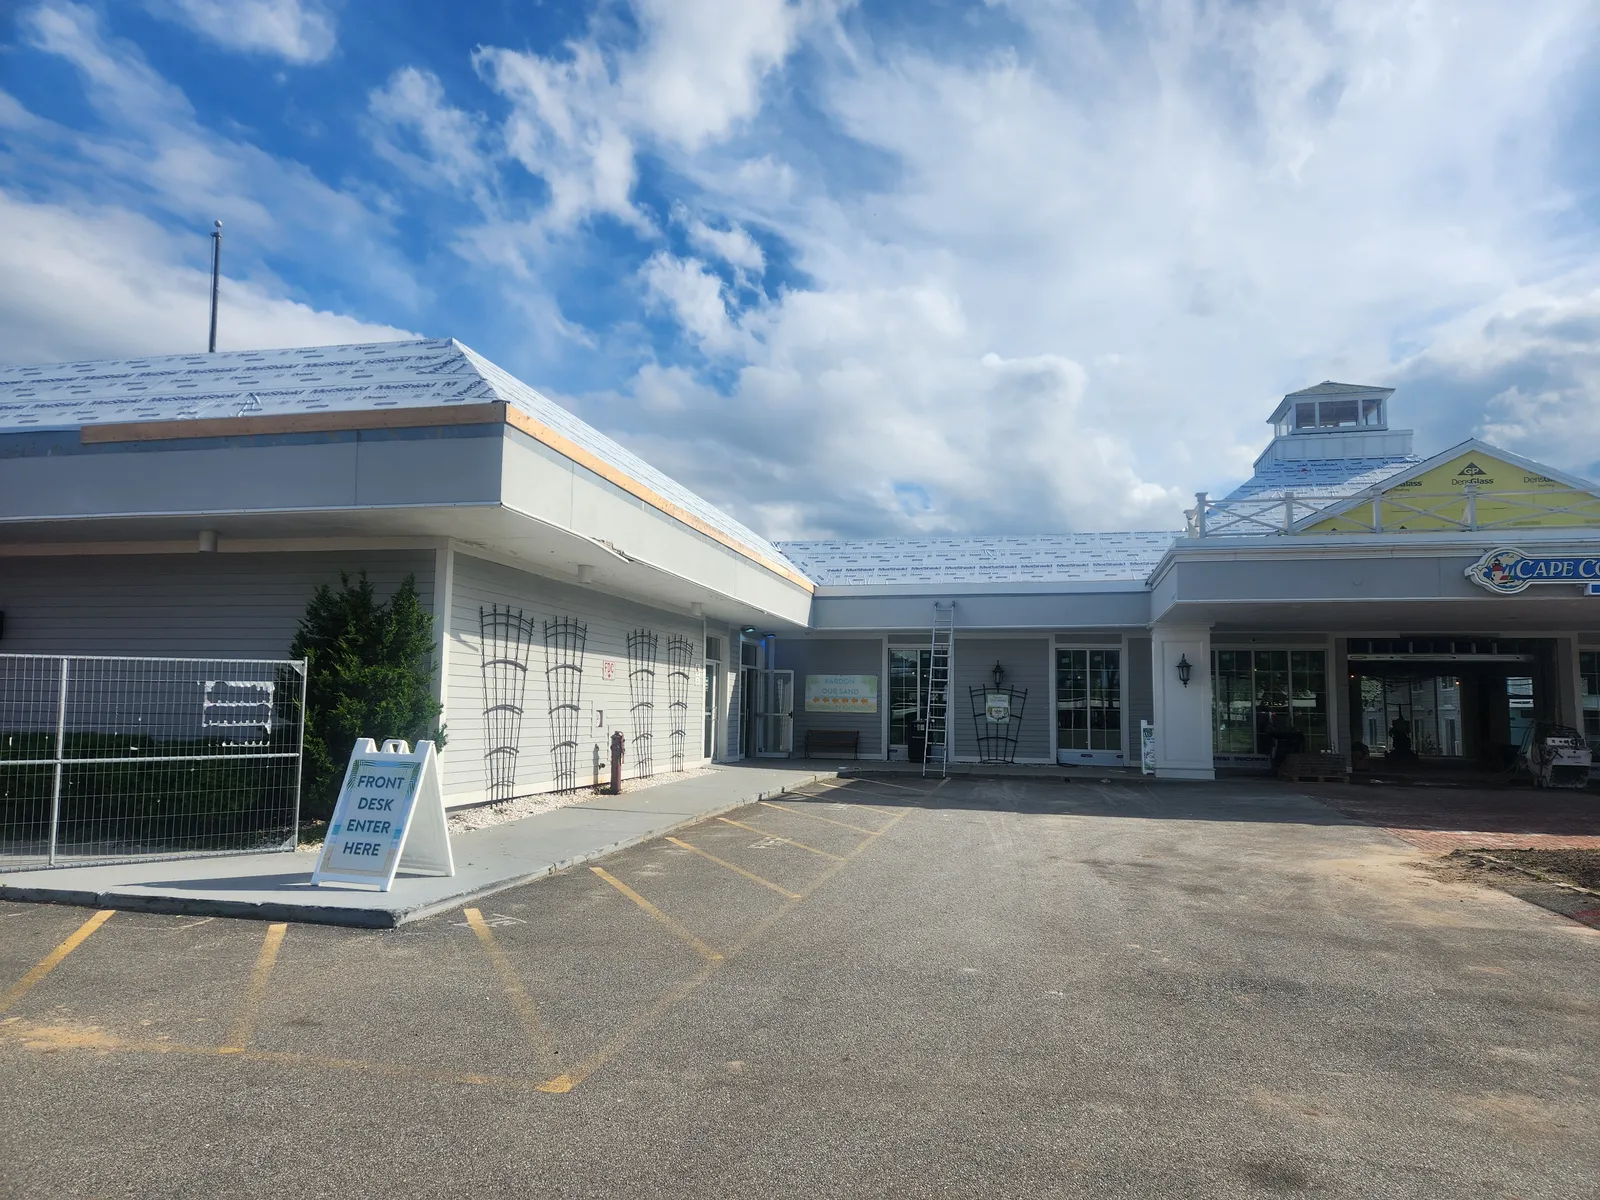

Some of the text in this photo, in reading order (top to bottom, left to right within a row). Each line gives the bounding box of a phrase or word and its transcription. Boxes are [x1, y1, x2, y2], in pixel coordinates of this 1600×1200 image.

[376, 382, 437, 391] MetShield
[1464, 467, 1479, 475] GP
[1516, 559, 1575, 579] CAPE
[604, 662, 614, 673] FDC
[821, 687, 838, 695] OUR
[357, 775, 405, 790] FRONT
[357, 797, 395, 812] DESK
[346, 818, 391, 834] ENTER
[342, 841, 381, 857] HERE
